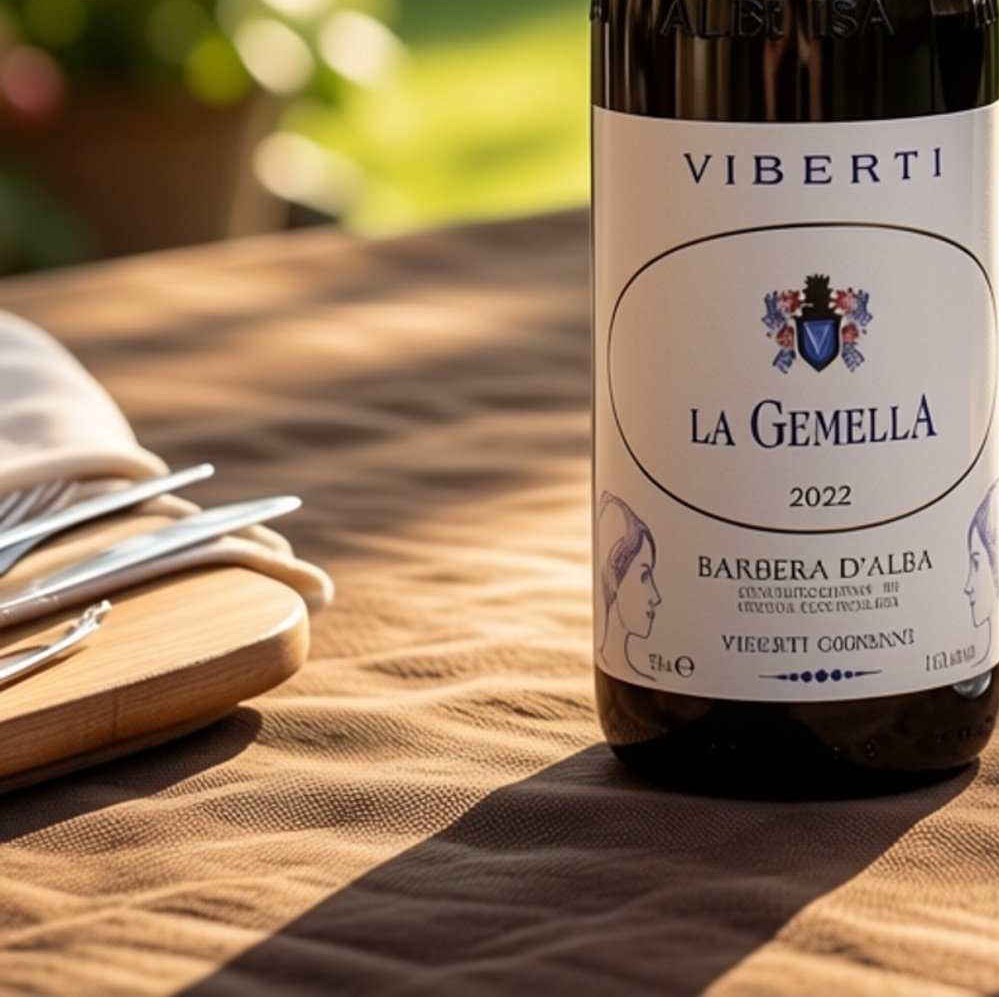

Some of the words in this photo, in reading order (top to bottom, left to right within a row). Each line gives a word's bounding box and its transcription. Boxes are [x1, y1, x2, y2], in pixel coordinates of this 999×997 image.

[684, 148, 942, 185] VIBERTI
[690, 408, 736, 446] LA
[751, 394, 937, 448] GEMELLA
[789, 485, 852, 507] 2022
[840, 550, 933, 580] D'ALBA
